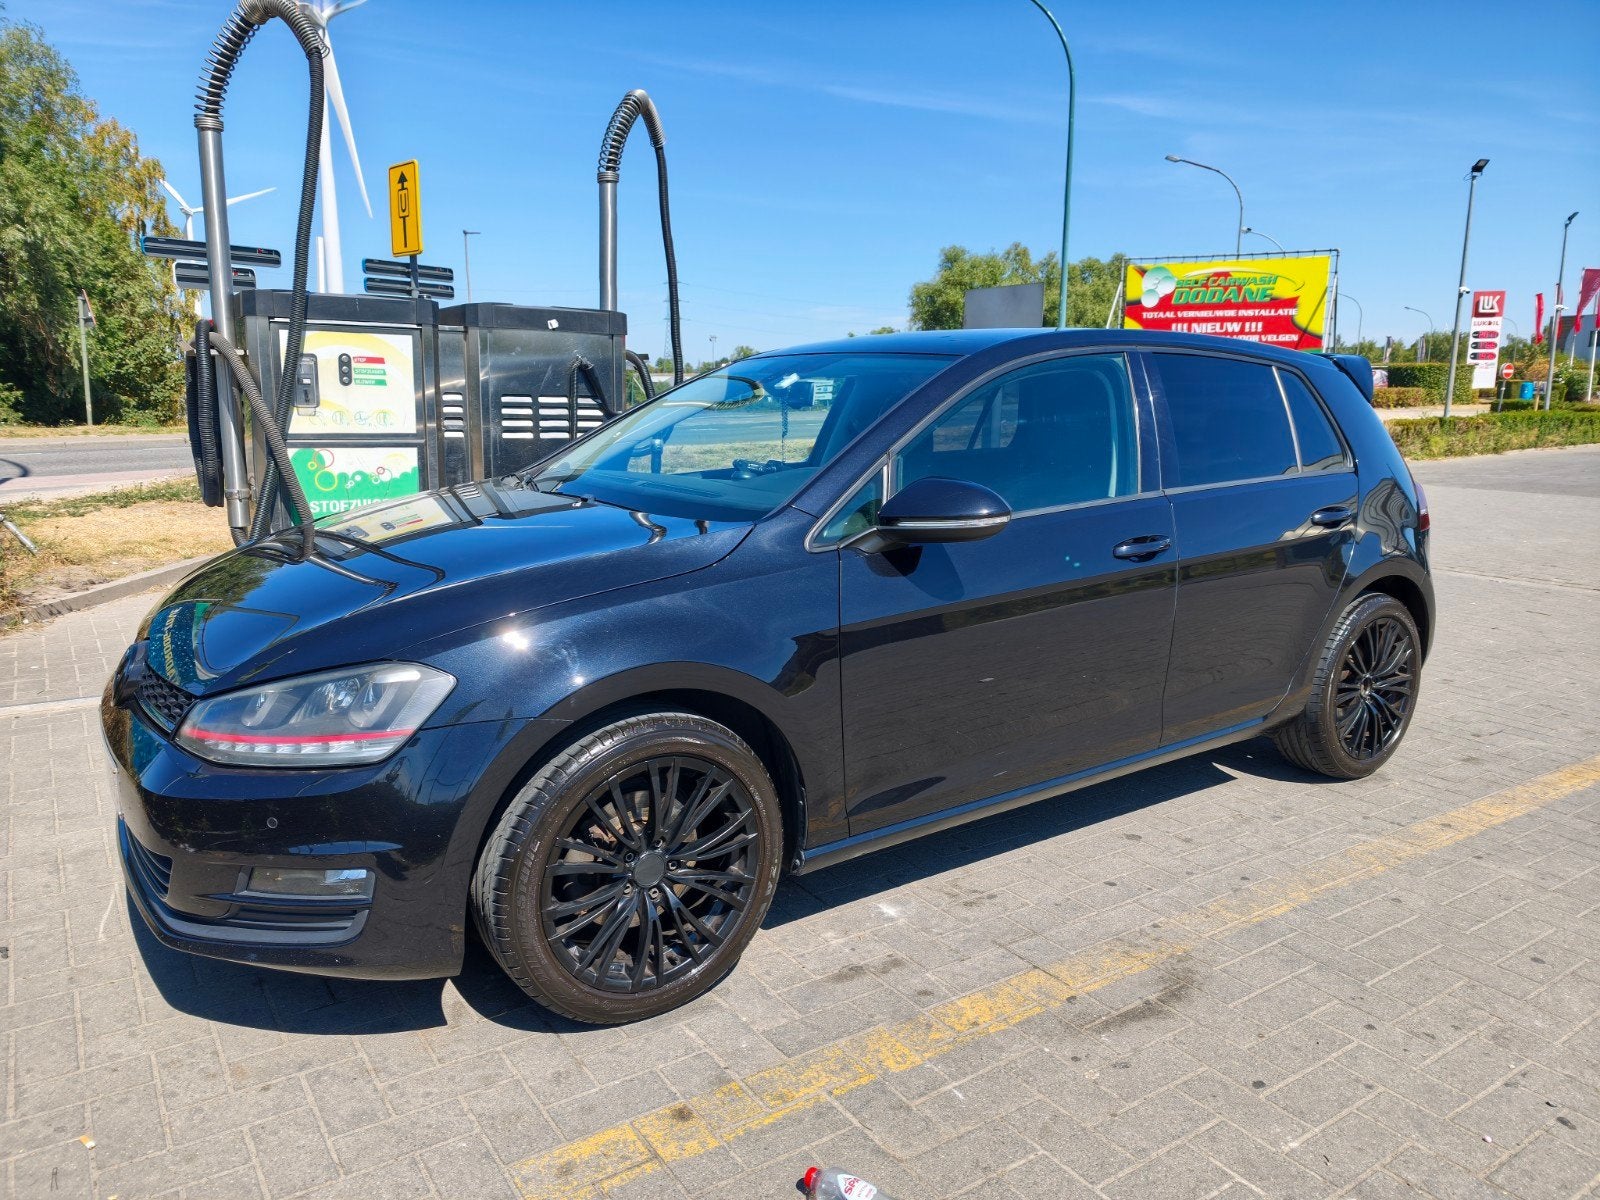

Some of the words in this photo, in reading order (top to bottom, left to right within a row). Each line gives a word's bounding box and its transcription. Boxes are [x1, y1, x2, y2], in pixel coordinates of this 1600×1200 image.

[1175, 278, 1207, 288] SELF
[1208, 276, 1278, 287] CARWASH
[1172, 287, 1275, 304] DODANE
[1142, 311, 1176, 319] TOTAAL
[1177, 309, 1238, 318] VERNIEUWDE
[1238, 308, 1299, 317] INSTALLATIE
[1190, 322, 1243, 334] NIEUW
[1244, 322, 1263, 332] !!!
[1260, 333, 1299, 342] VELGEN
[309, 498, 389, 514] STOFZU
